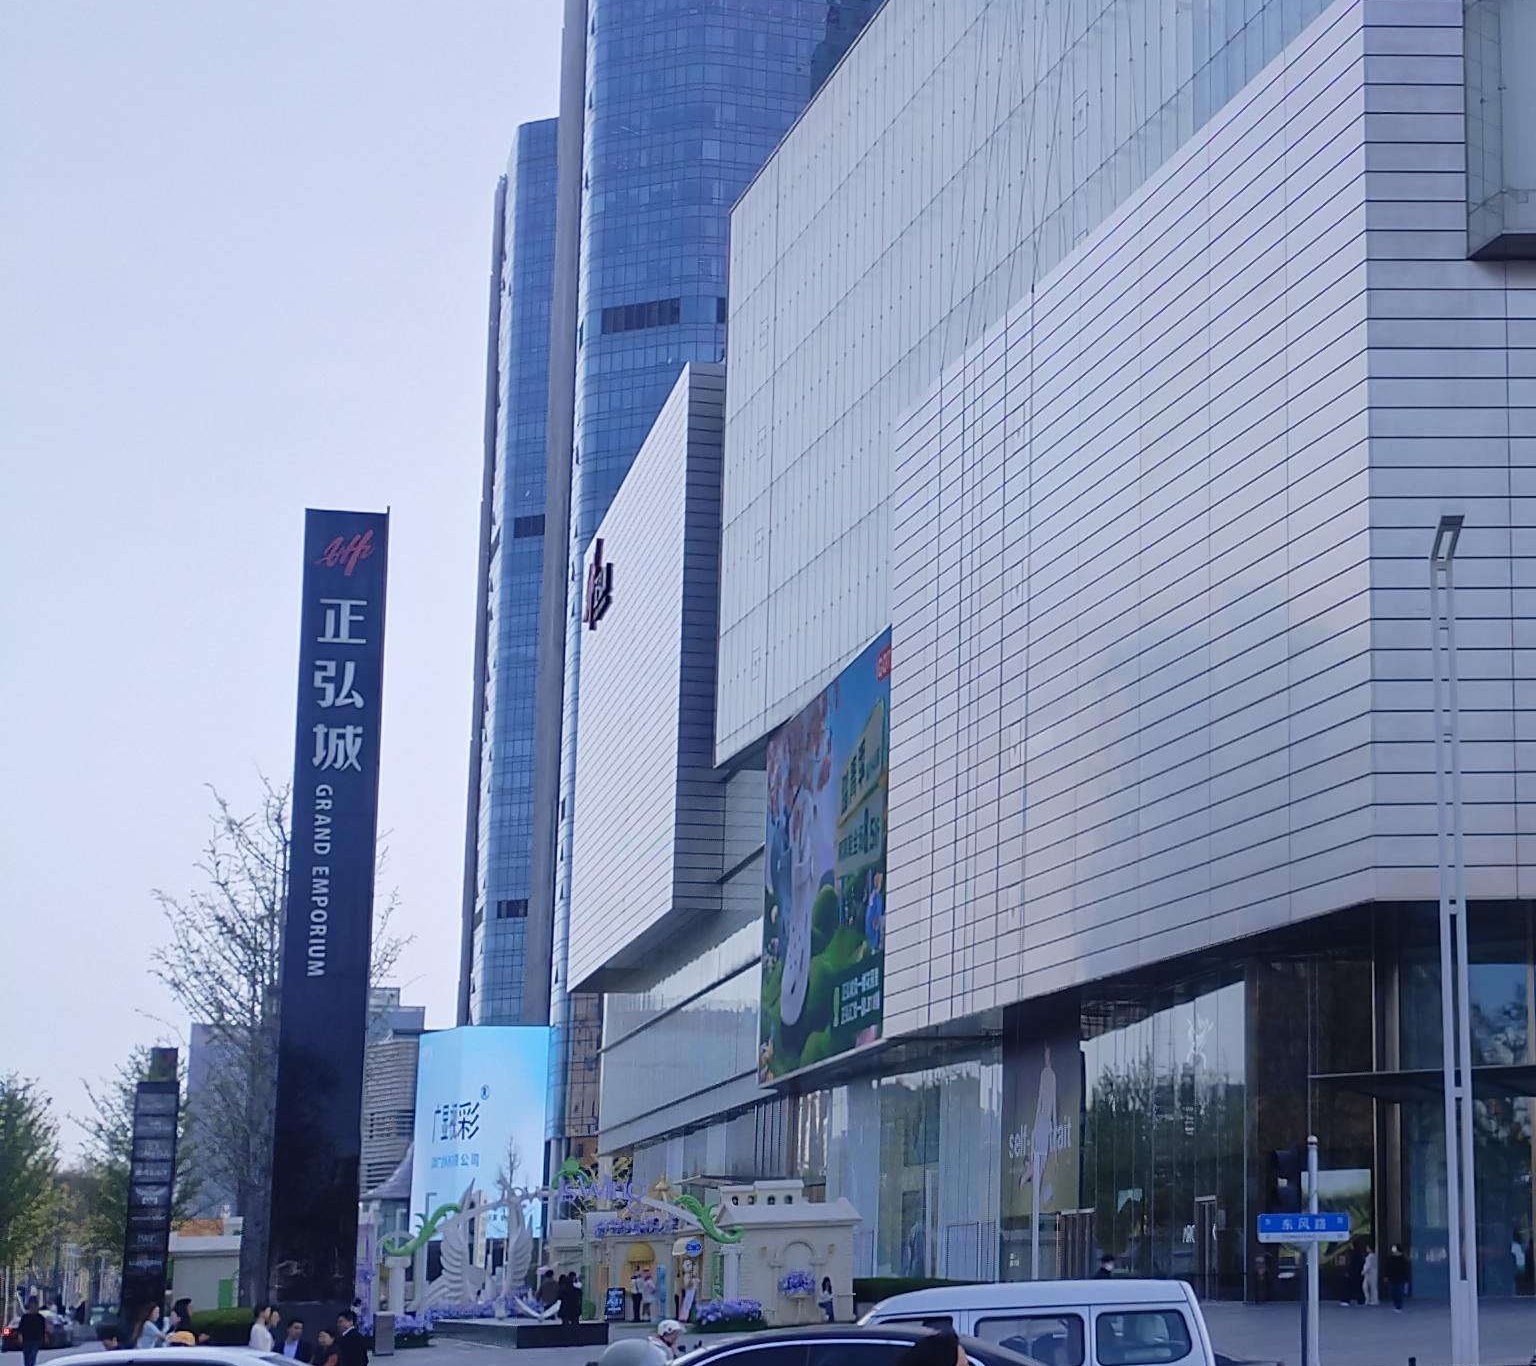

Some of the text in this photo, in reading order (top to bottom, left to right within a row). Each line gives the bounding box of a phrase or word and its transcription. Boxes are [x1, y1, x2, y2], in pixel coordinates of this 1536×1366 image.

[312, 597, 368, 773] 正弘城
[305, 784, 334, 978] GRAND EMPORIUM
